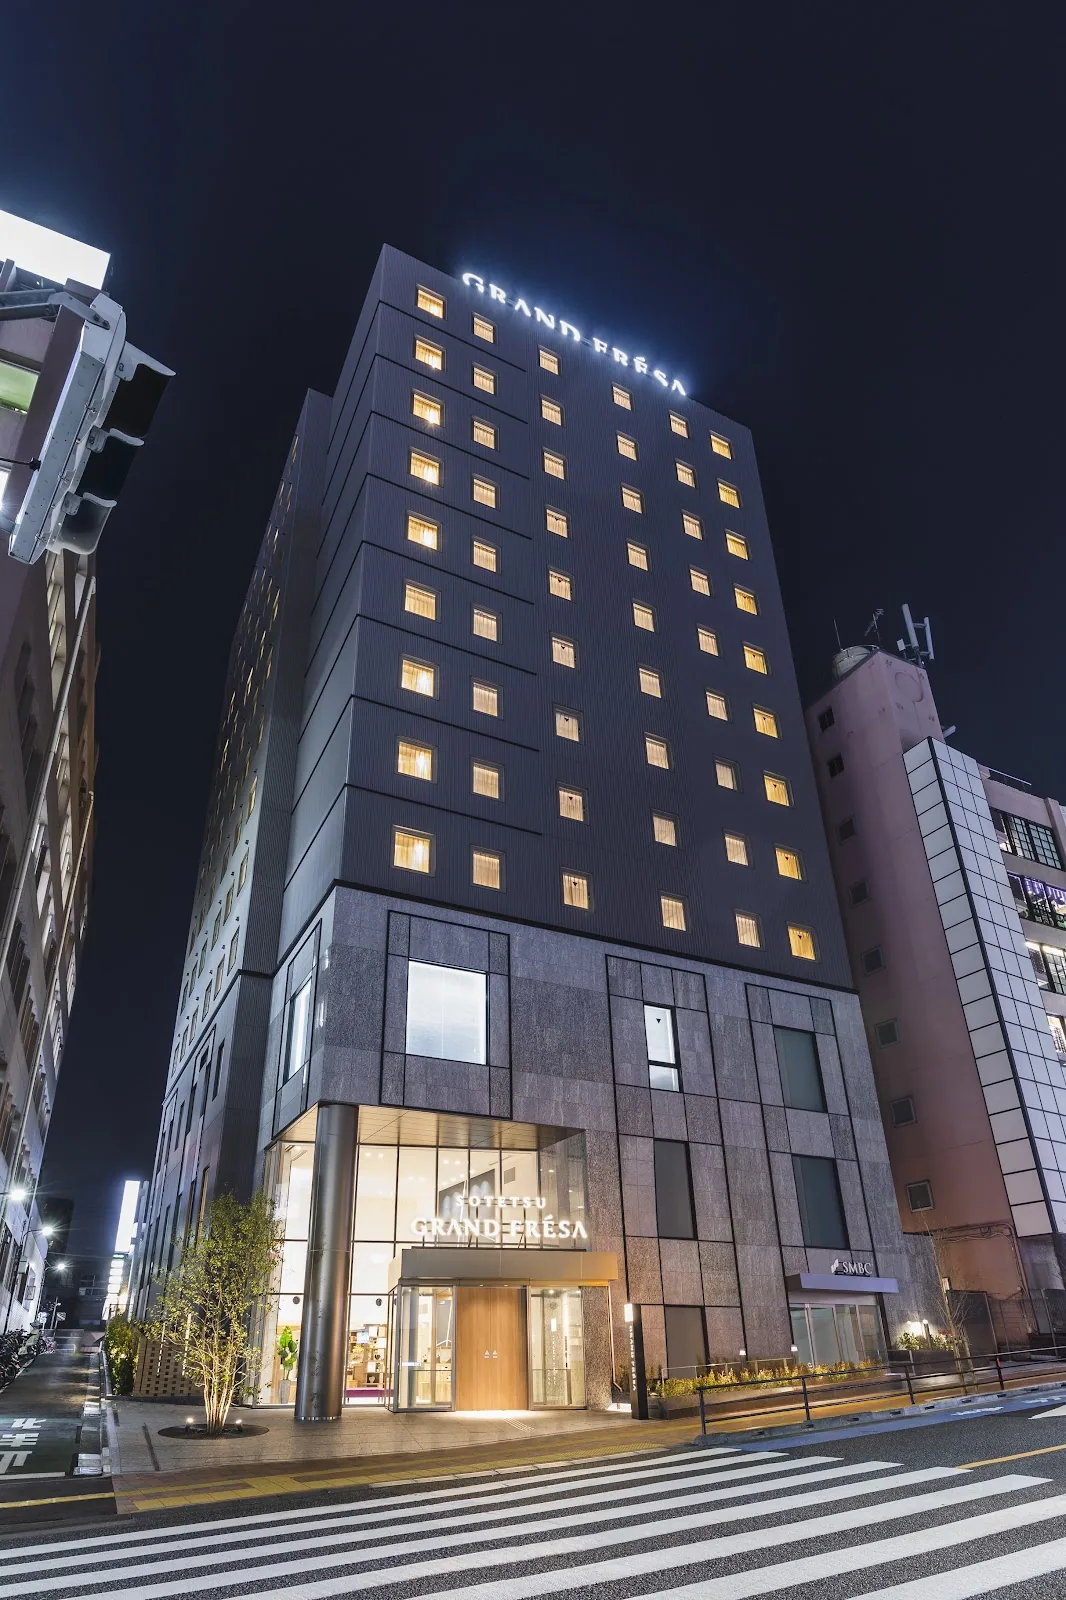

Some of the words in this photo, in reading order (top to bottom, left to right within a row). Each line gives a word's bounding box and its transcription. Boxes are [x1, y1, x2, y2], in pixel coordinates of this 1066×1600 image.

[462, 272, 581, 342] GRAND
[592, 337, 687, 396] FRÉSA
[456, 1195, 546, 1209] SOTETSU
[411, 1217, 500, 1237] GRAND
[510, 1214, 588, 1239] FRÉSA
[842, 1261, 873, 1275] SMBC
